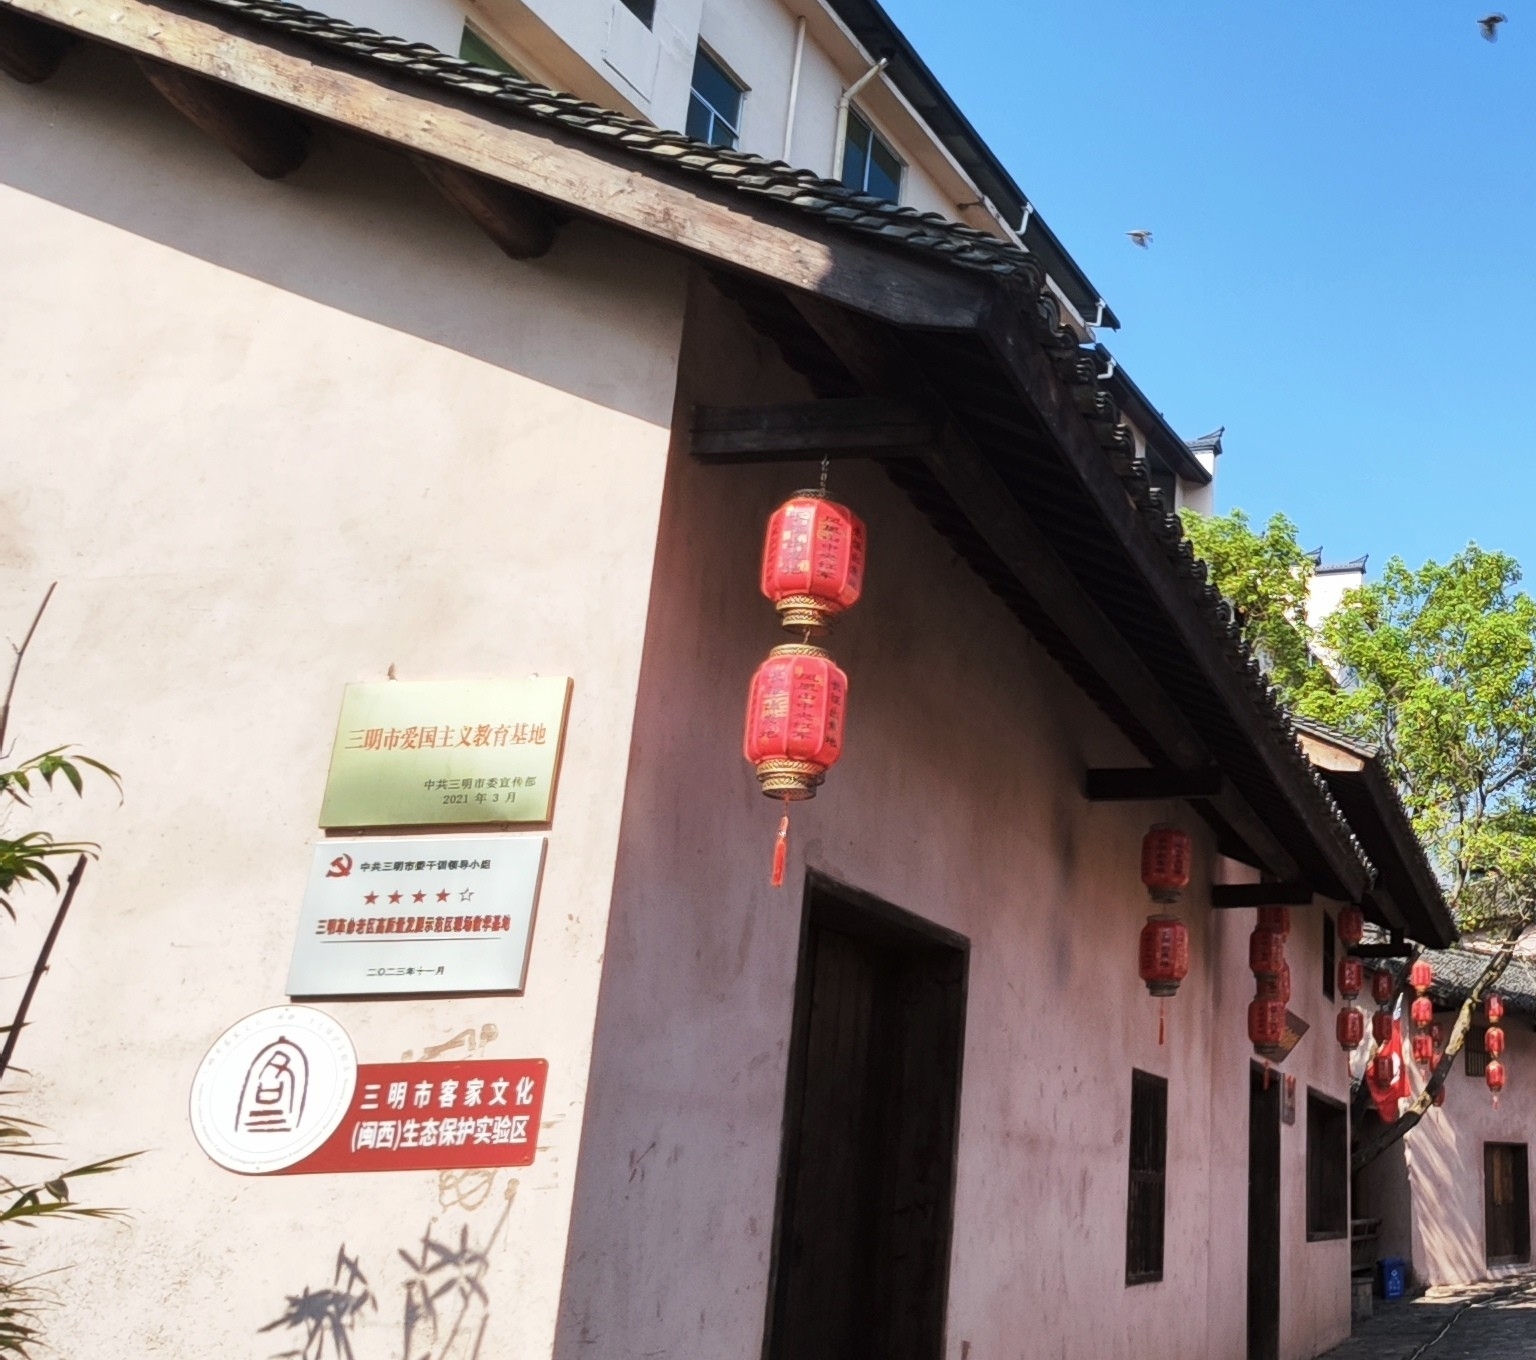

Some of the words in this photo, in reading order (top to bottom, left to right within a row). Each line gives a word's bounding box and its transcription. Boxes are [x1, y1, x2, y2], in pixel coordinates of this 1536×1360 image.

[345, 722, 547, 751] 三明市爱国主义教育基地
[424, 776, 537, 791] 中共三明市委宣传部
[360, 1076, 535, 1110] 三明市客家文化
[352, 1115, 530, 1153] (闽西)生态保护实验区
